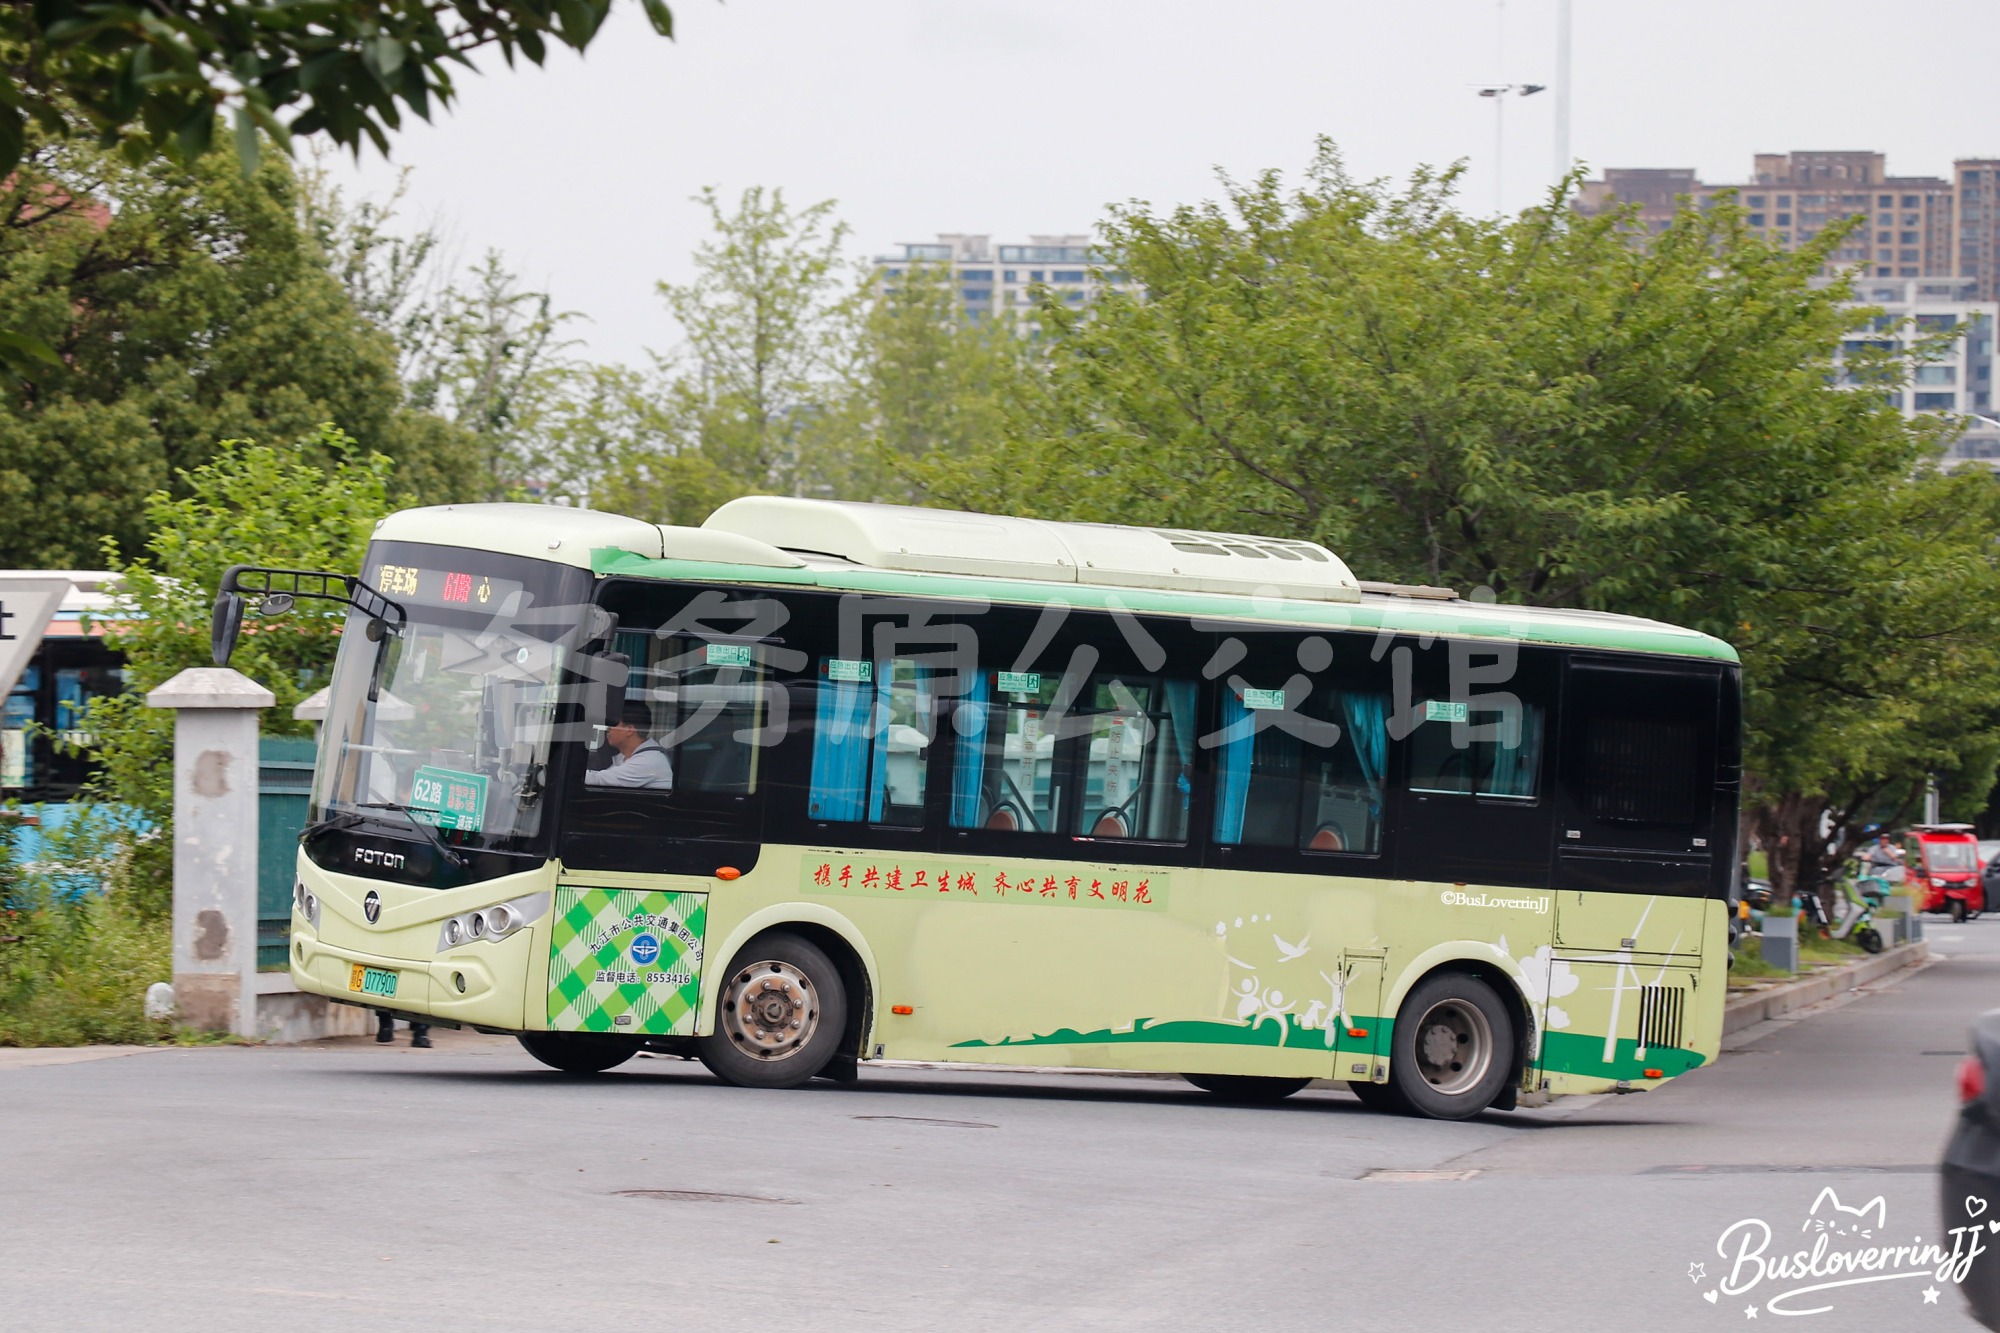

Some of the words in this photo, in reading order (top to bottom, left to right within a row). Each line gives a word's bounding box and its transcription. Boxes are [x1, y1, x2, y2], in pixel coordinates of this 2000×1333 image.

[379, 565, 419, 596] 停车场
[414, 778, 442, 805] 62路
[355, 847, 405, 869] FOTON
[814, 863, 979, 898] 携手共建卫生城
[992, 871, 1153, 904] 齐心共育文明花
[589, 914, 704, 961] 九江市公共交通集团公司
[646, 973, 690, 984] 8553416
